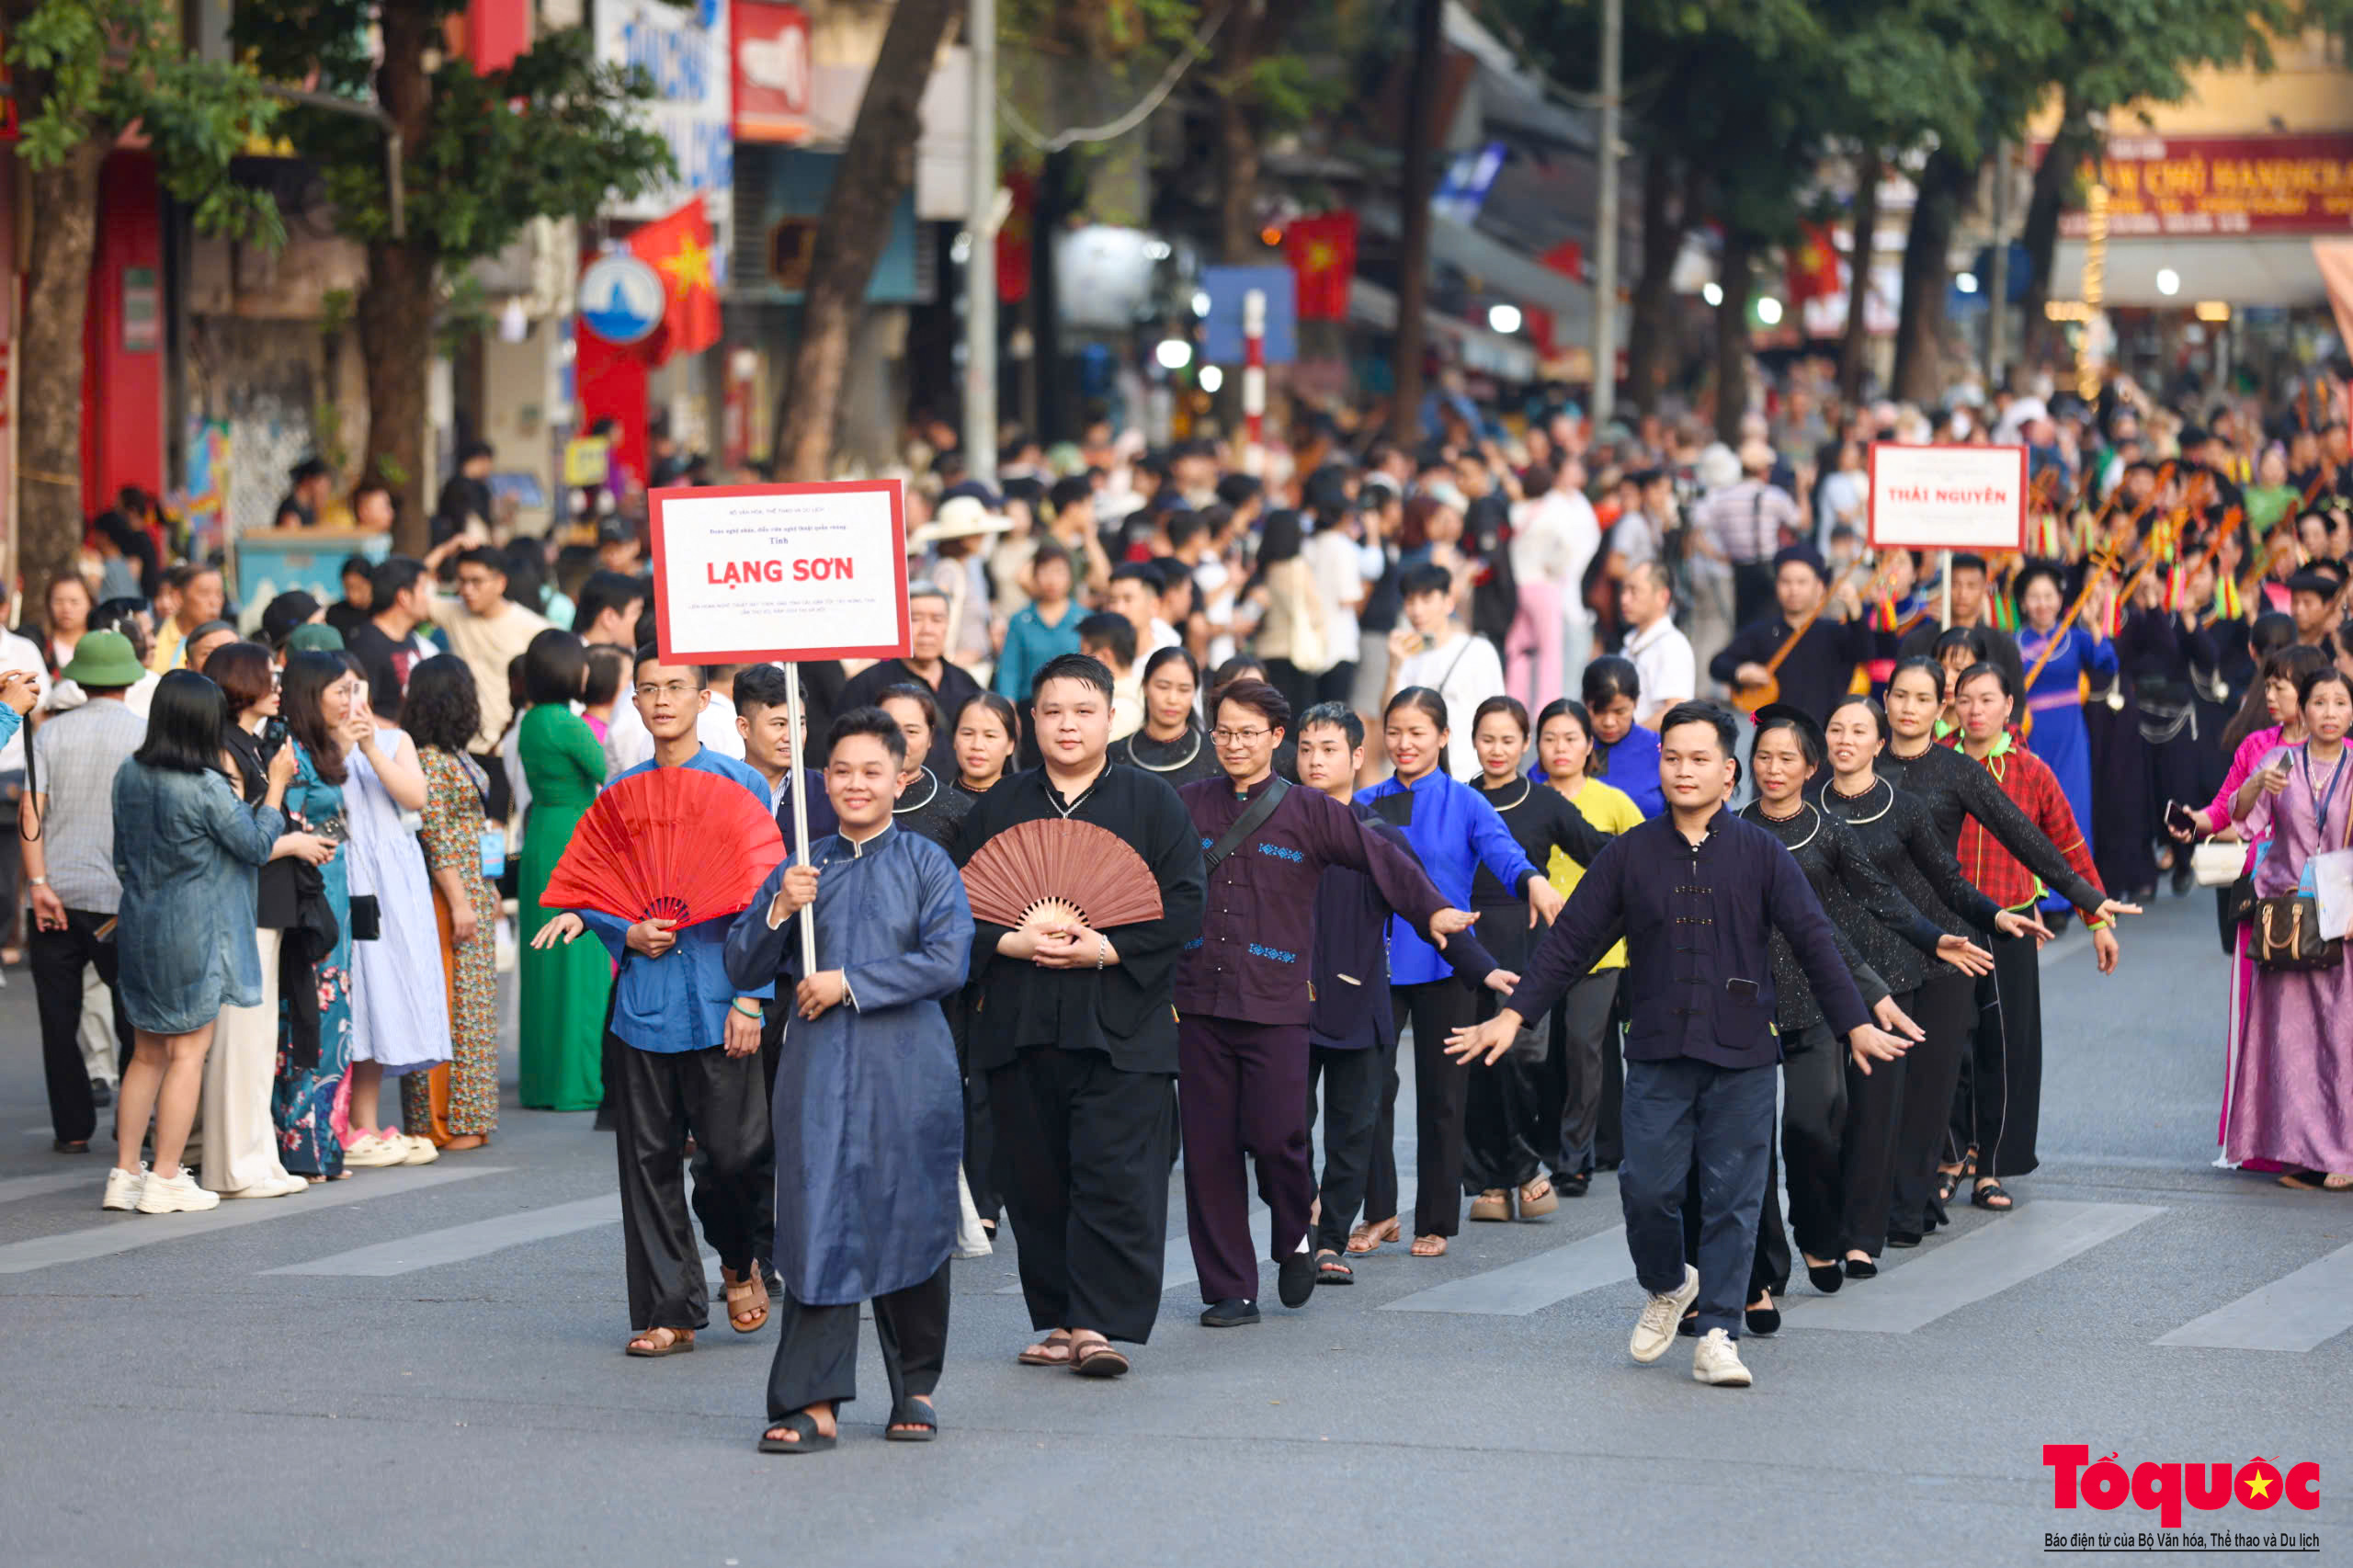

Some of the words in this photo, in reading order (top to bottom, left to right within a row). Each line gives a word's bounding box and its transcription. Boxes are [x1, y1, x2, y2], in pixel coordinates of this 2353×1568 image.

[1888, 485, 1929, 504] THÁI
[1935, 486, 2007, 505] NGUYÊN
[707, 560, 783, 589] LẠNG
[793, 557, 854, 582] SƠN
